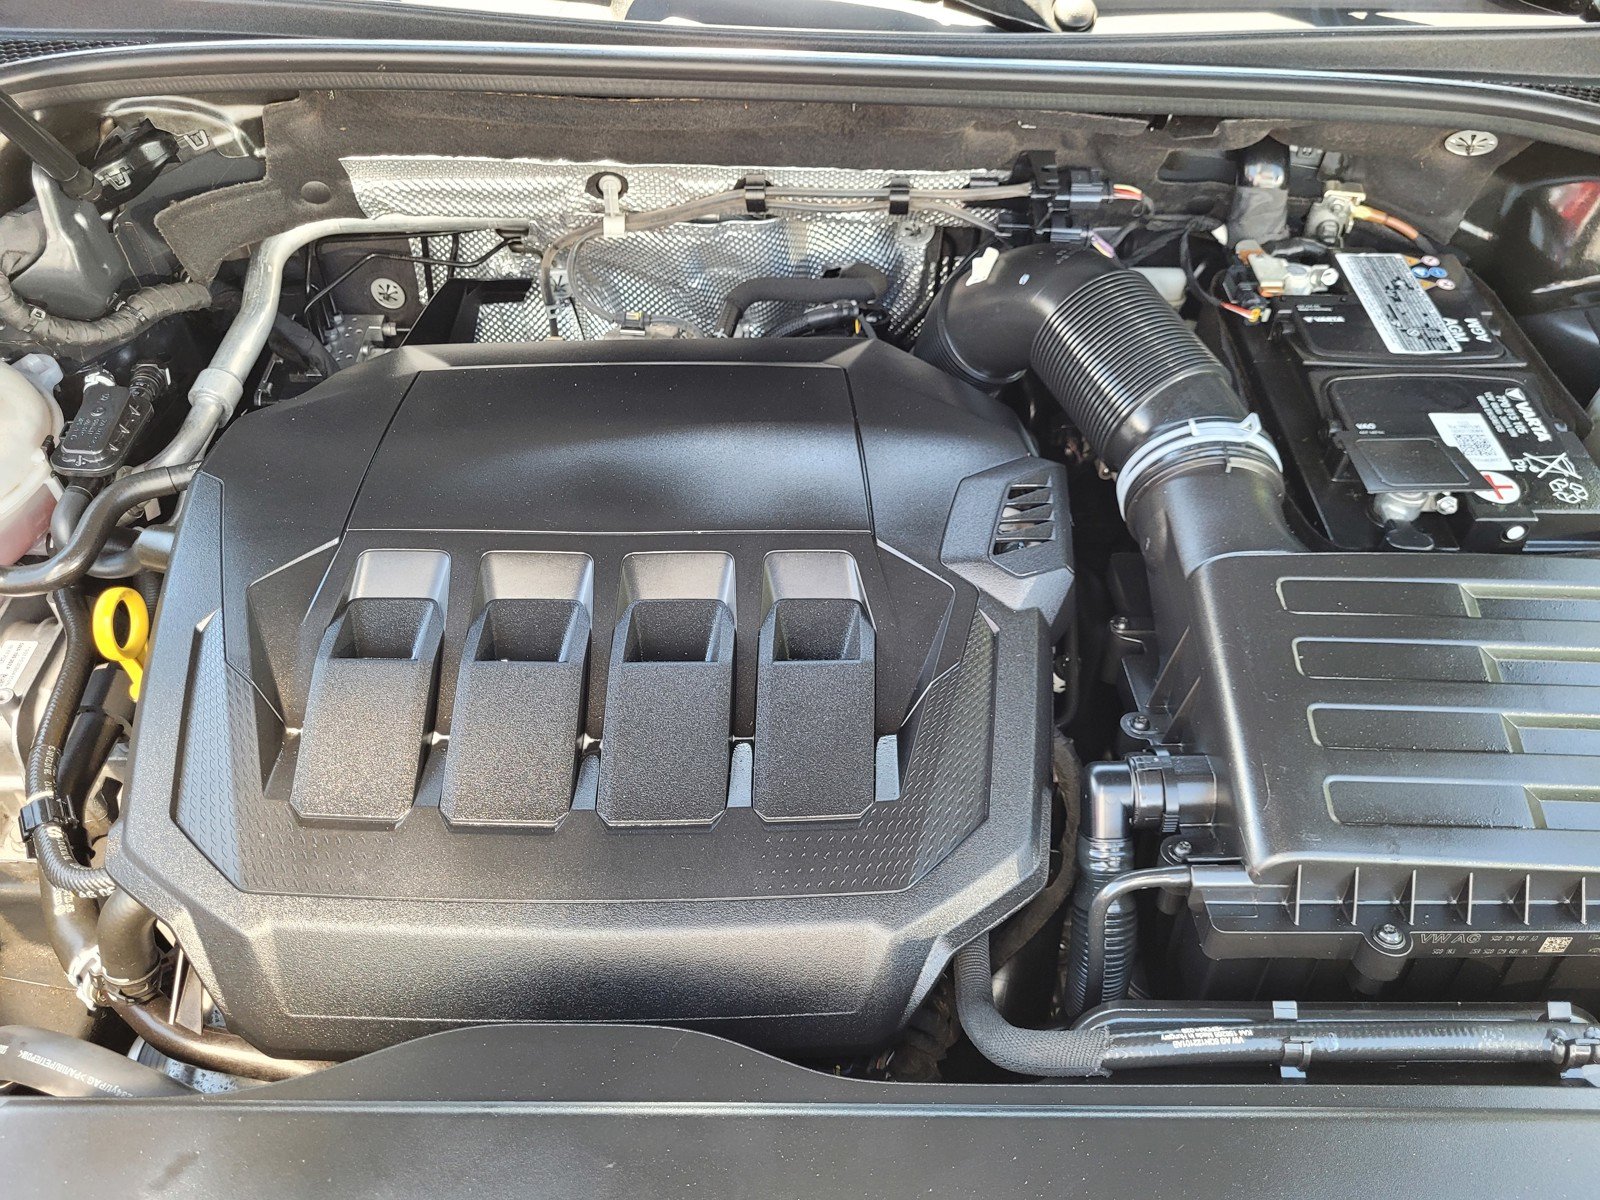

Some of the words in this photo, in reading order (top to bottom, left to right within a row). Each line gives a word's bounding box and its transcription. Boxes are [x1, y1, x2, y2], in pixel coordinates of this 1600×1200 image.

[1442, 317, 1470, 342] AGM
[1463, 317, 1492, 343] AGM
[1515, 401, 1553, 442] VARTA
[1510, 459, 1529, 472] Pb
[1420, 933, 1451, 944] VW
[1450, 933, 1482, 944] AG
